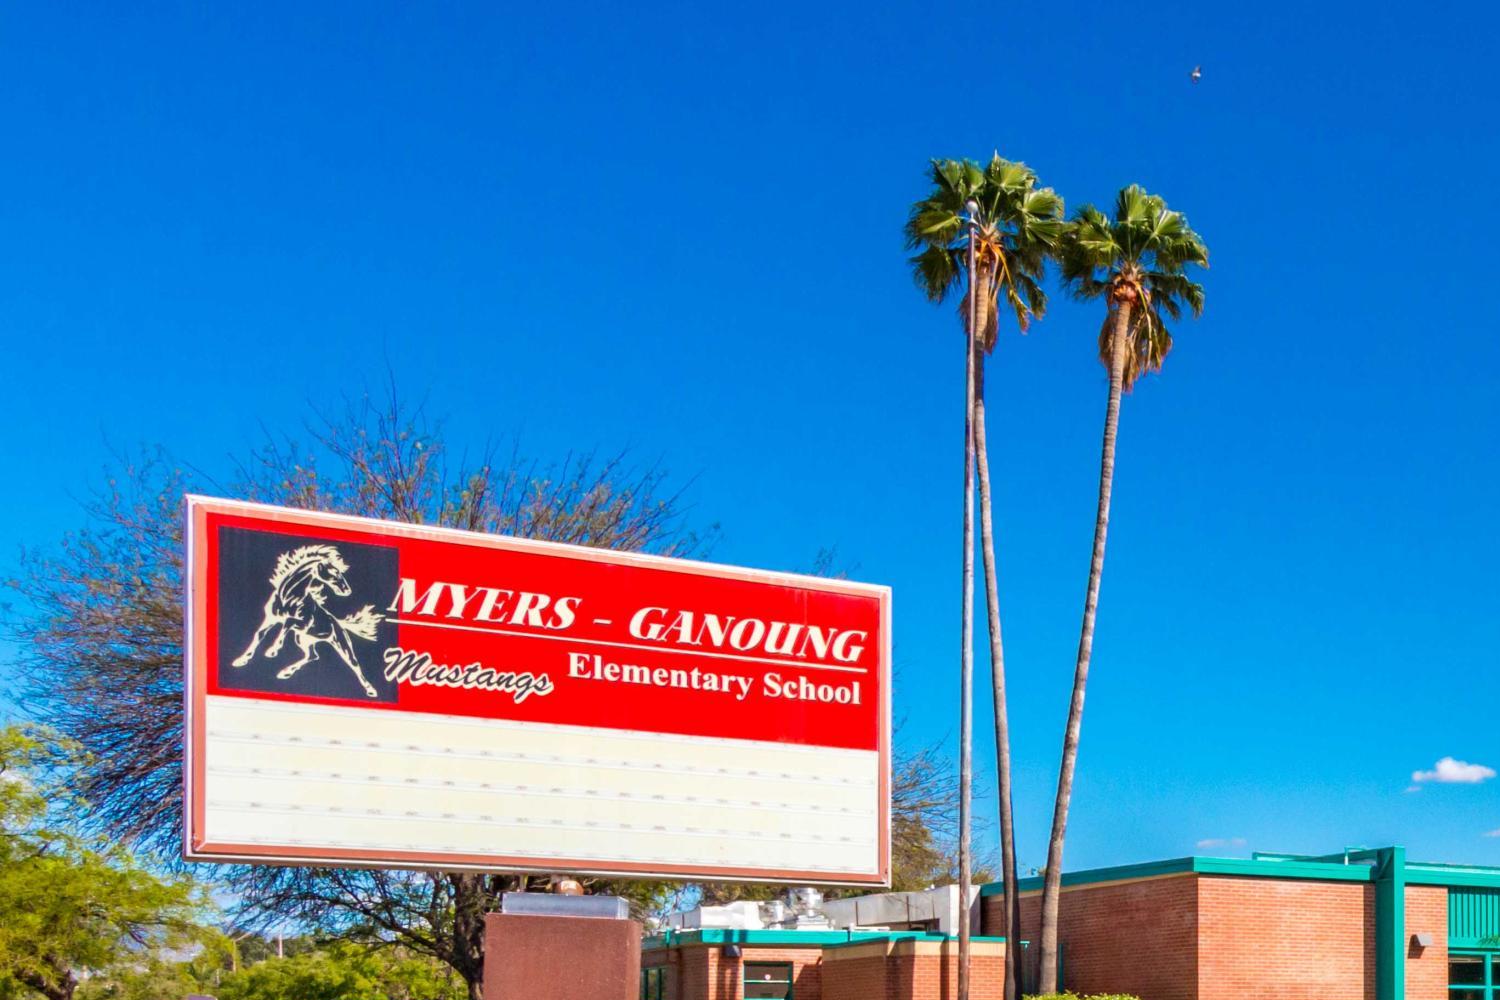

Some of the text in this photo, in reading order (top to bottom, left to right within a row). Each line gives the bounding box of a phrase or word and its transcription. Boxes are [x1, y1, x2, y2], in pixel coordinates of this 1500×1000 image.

[386, 577, 582, 630] MYERS
[628, 606, 868, 663] GANOUNG
[383, 647, 555, 704] Mustangs
[567, 652, 861, 705] Elementary School
